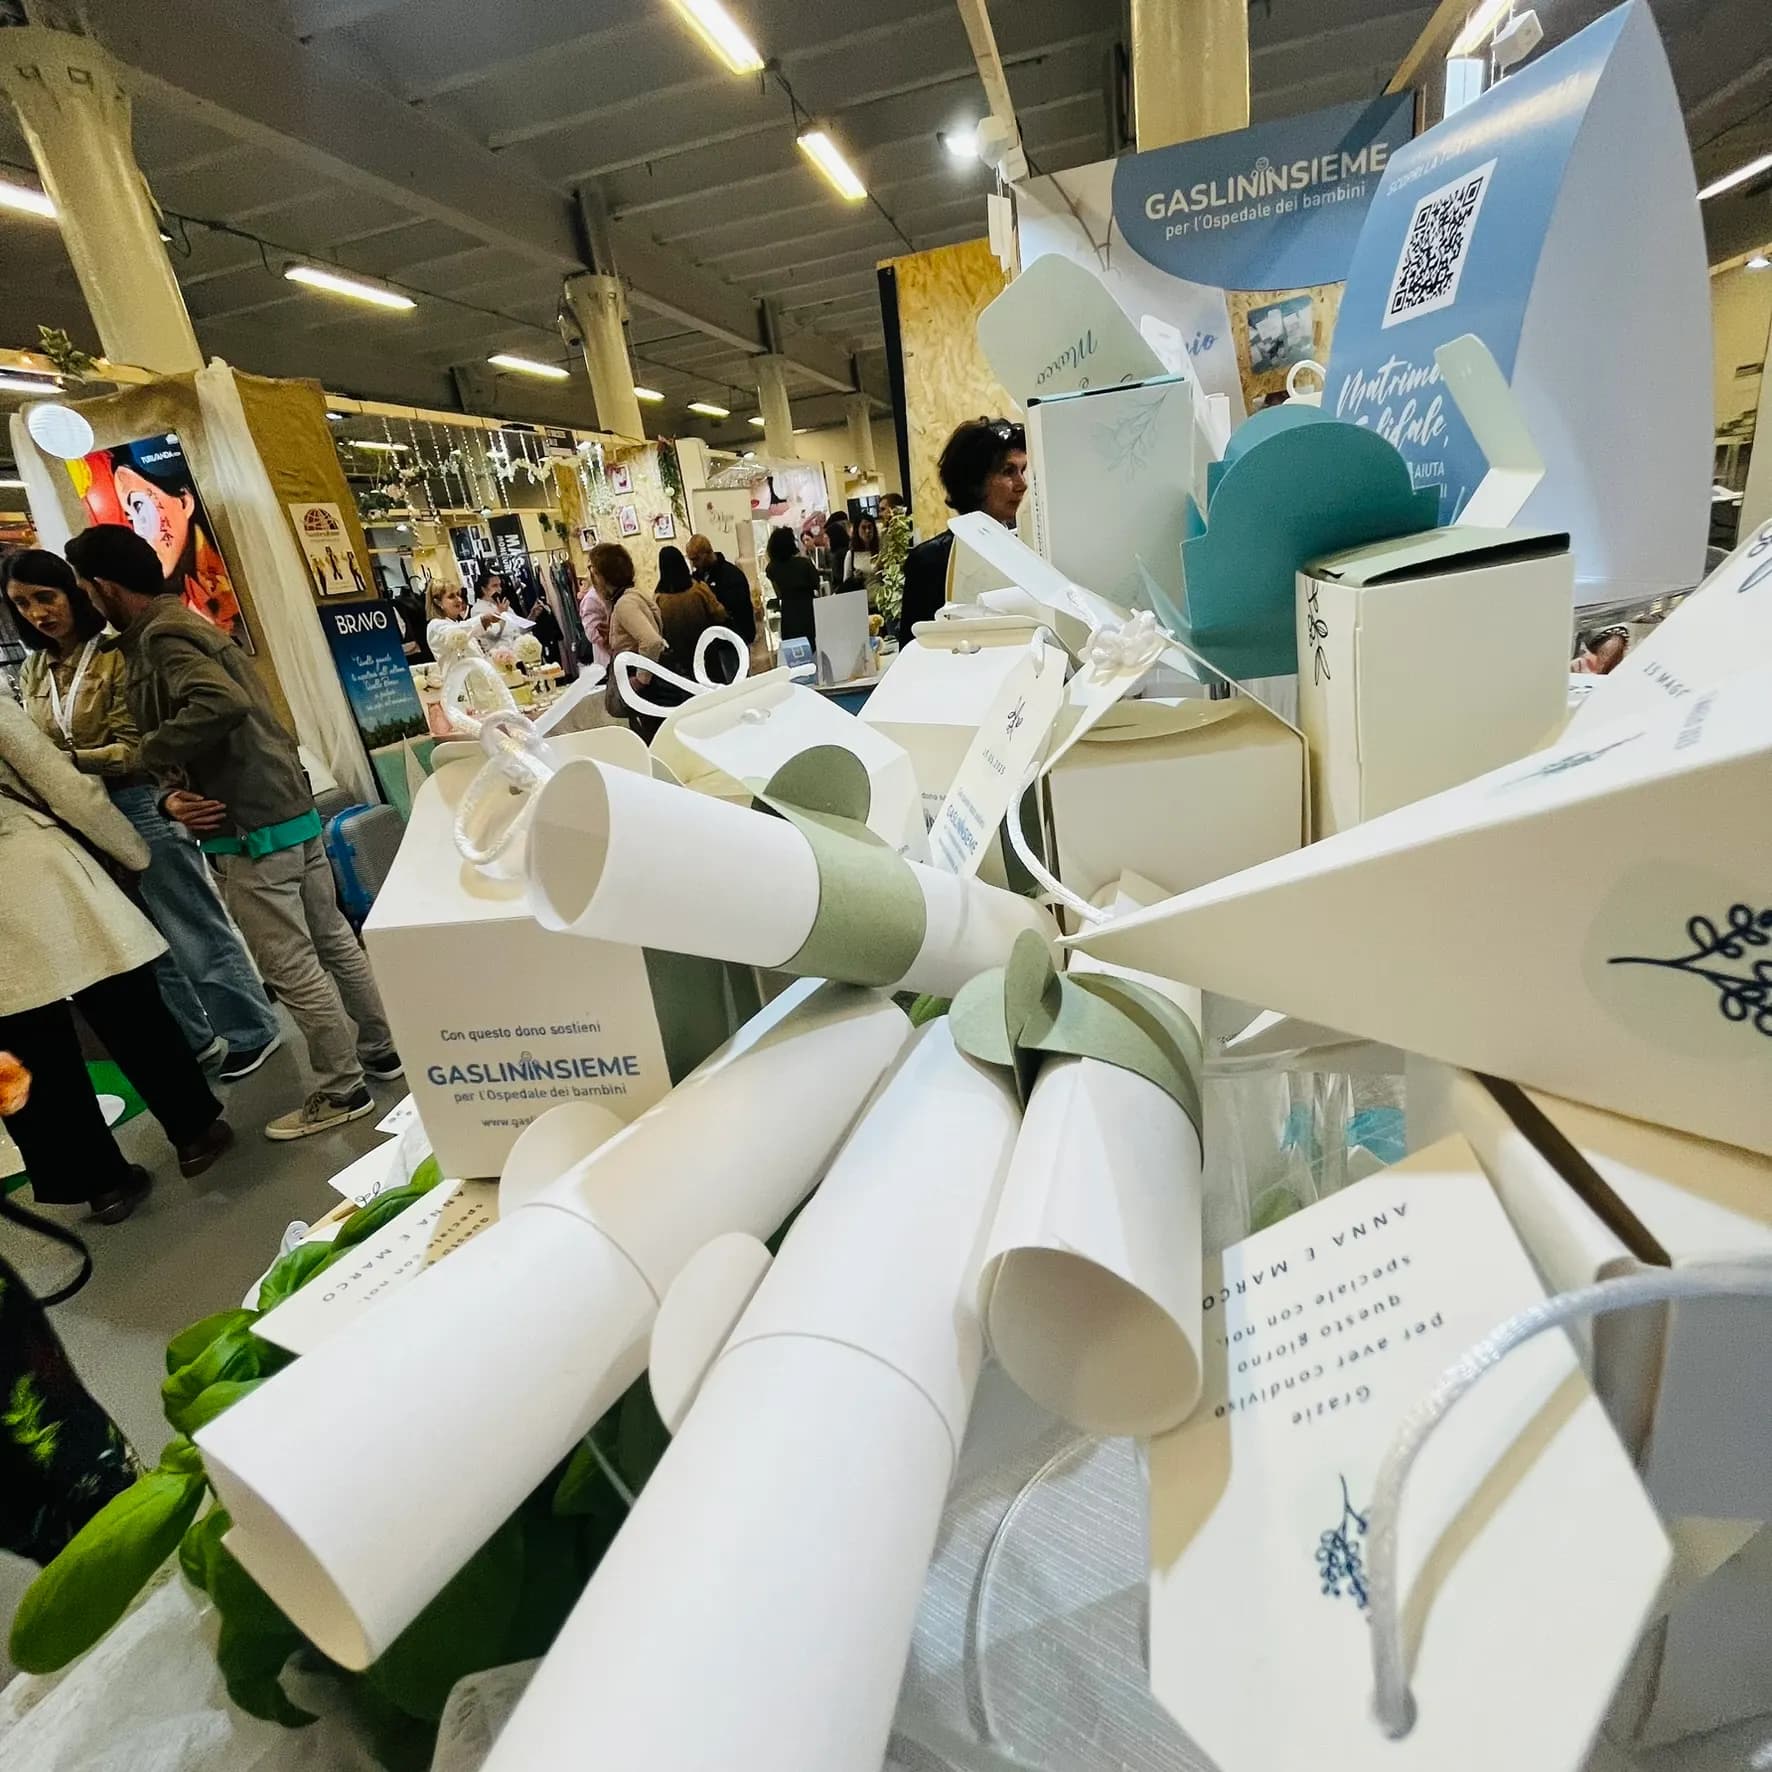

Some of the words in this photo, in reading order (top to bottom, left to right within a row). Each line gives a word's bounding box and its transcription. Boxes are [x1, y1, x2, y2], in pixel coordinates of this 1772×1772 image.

[1165, 222, 1189, 241] per
[1193, 203, 1271, 232] l'Ospedale
[1275, 195, 1299, 214] dei
[1302, 180, 1366, 208] bambini
[1037, 329, 1098, 385] Marco
[1336, 354, 1444, 418] Matrimo
[1414, 461, 1445, 479] AIUTA
[334, 610, 387, 635] BRAVO
[440, 1029, 465, 1042] Con
[468, 1025, 512, 1042] questo
[550, 1022, 601, 1035] sostieni
[454, 1090, 475, 1104] per
[479, 1085, 547, 1103] l'Ospedale
[550, 1084, 570, 1098] dei
[573, 1082, 627, 1097] bambini
[416, 1190, 465, 1227] ANNA
[426, 1204, 484, 1250] speciale
[1331, 1202, 1408, 1247] ANNA
[400, 1233, 411, 1242] E
[1304, 1247, 1316, 1261] E
[322, 1248, 392, 1303] MARCO
[394, 1253, 421, 1275] con
[1315, 1255, 1412, 1306] speciale
[1201, 1260, 1289, 1311] MARCO
[1267, 1304, 1304, 1327] con
[1319, 1294, 1401, 1338] questo
[1402, 1311, 1444, 1341] per
[1237, 1331, 1309, 1374] giorno
[1336, 1337, 1389, 1368] aver
[1214, 1364, 1324, 1419] condiviso
[1292, 1384, 1371, 1425] Grazie
